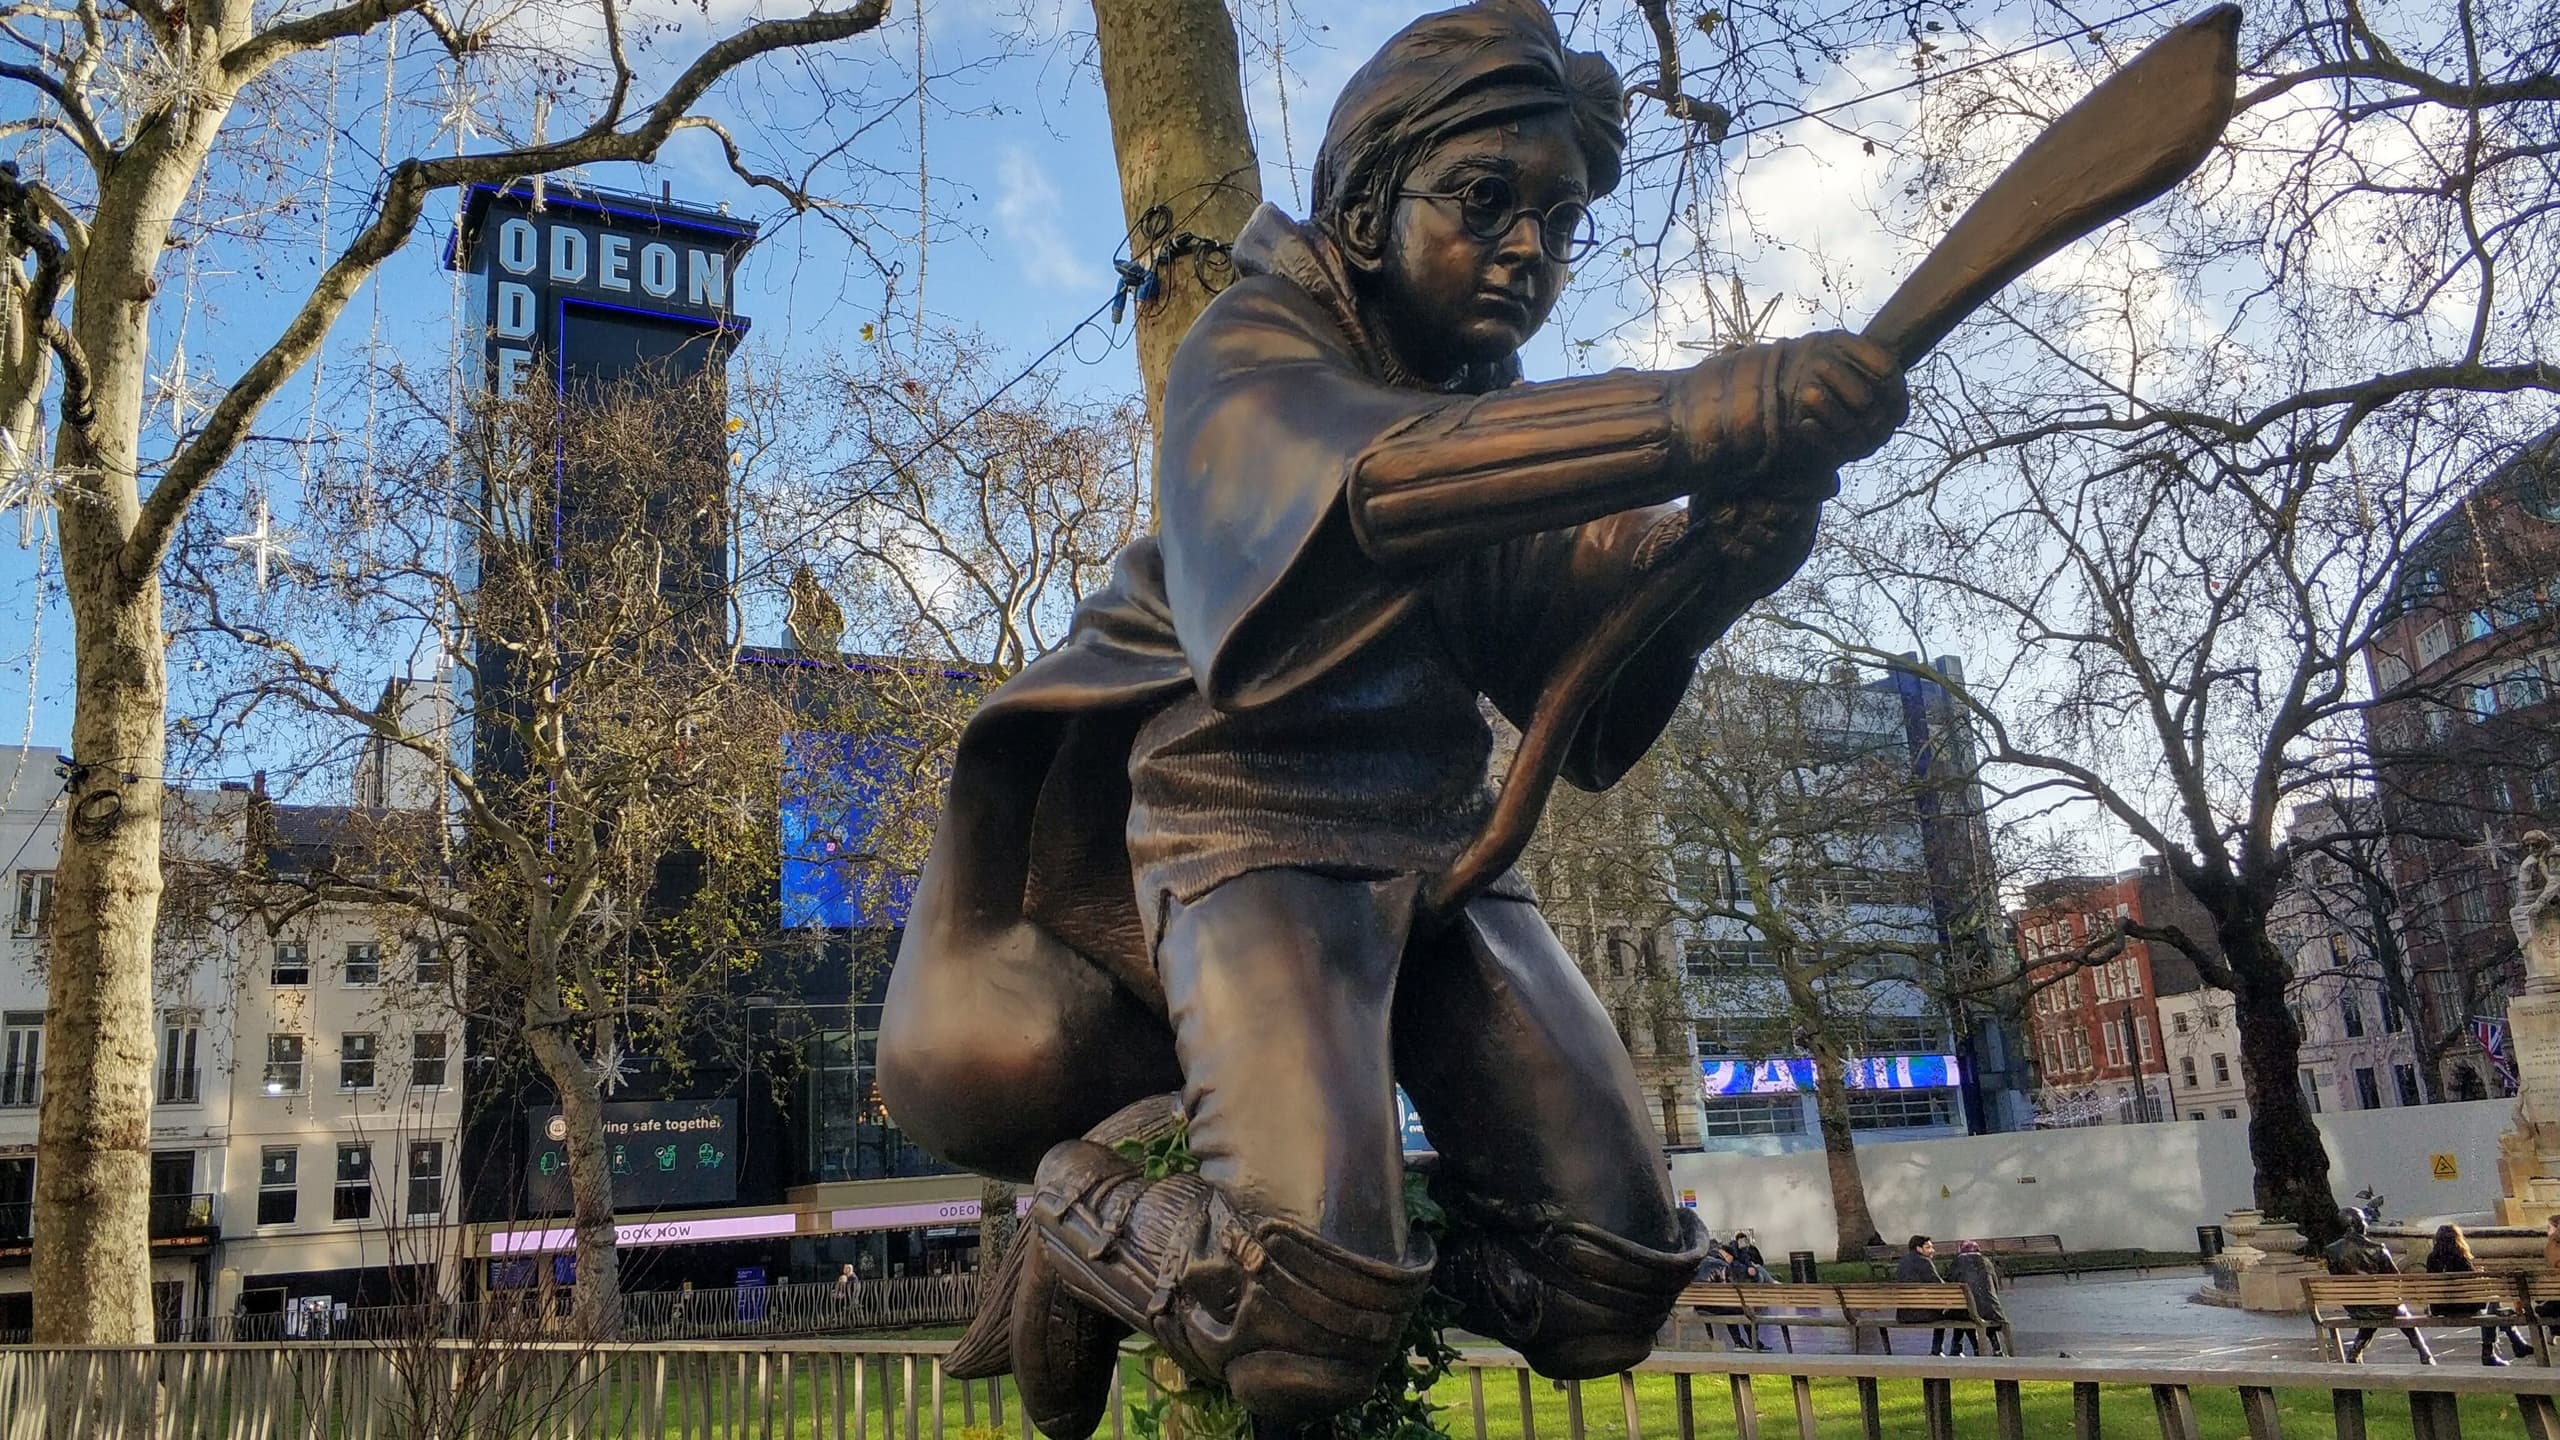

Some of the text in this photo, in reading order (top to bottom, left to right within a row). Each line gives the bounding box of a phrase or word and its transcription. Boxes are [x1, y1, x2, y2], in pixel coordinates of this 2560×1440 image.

[499, 218, 725, 307] ODEON
[633, 1119, 661, 1132] safe
[665, 1117, 721, 1132] together
[657, 1226, 691, 1238] NOW
